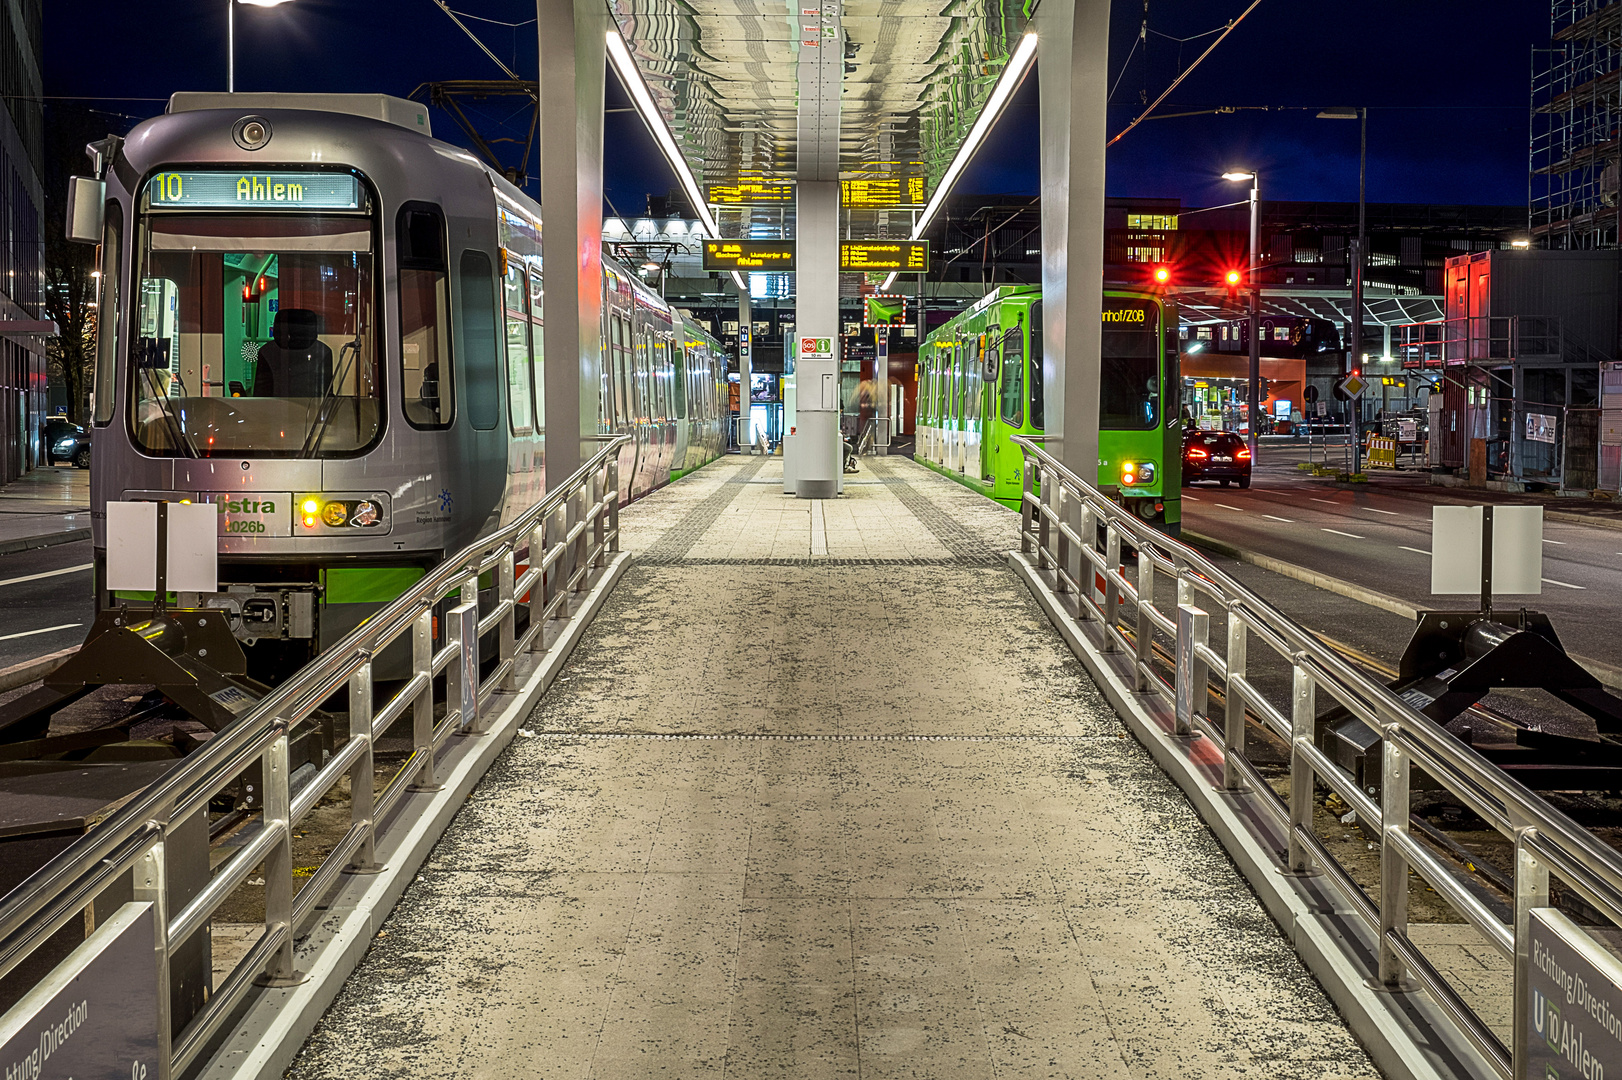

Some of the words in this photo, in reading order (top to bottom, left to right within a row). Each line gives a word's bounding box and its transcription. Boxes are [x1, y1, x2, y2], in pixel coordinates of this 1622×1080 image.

[157, 173, 183, 201] 10
[236, 176, 303, 201] Ahlem
[708, 244, 717, 252] 10
[737, 258, 763, 266] Ahlem
[803, 342, 816, 350] SOS
[1534, 938, 1622, 1042] Richtung/Direction
[1534, 989, 1545, 1033] U
[1548, 1010, 1559, 1044] 10
[1560, 1020, 1604, 1080] Ahlem
